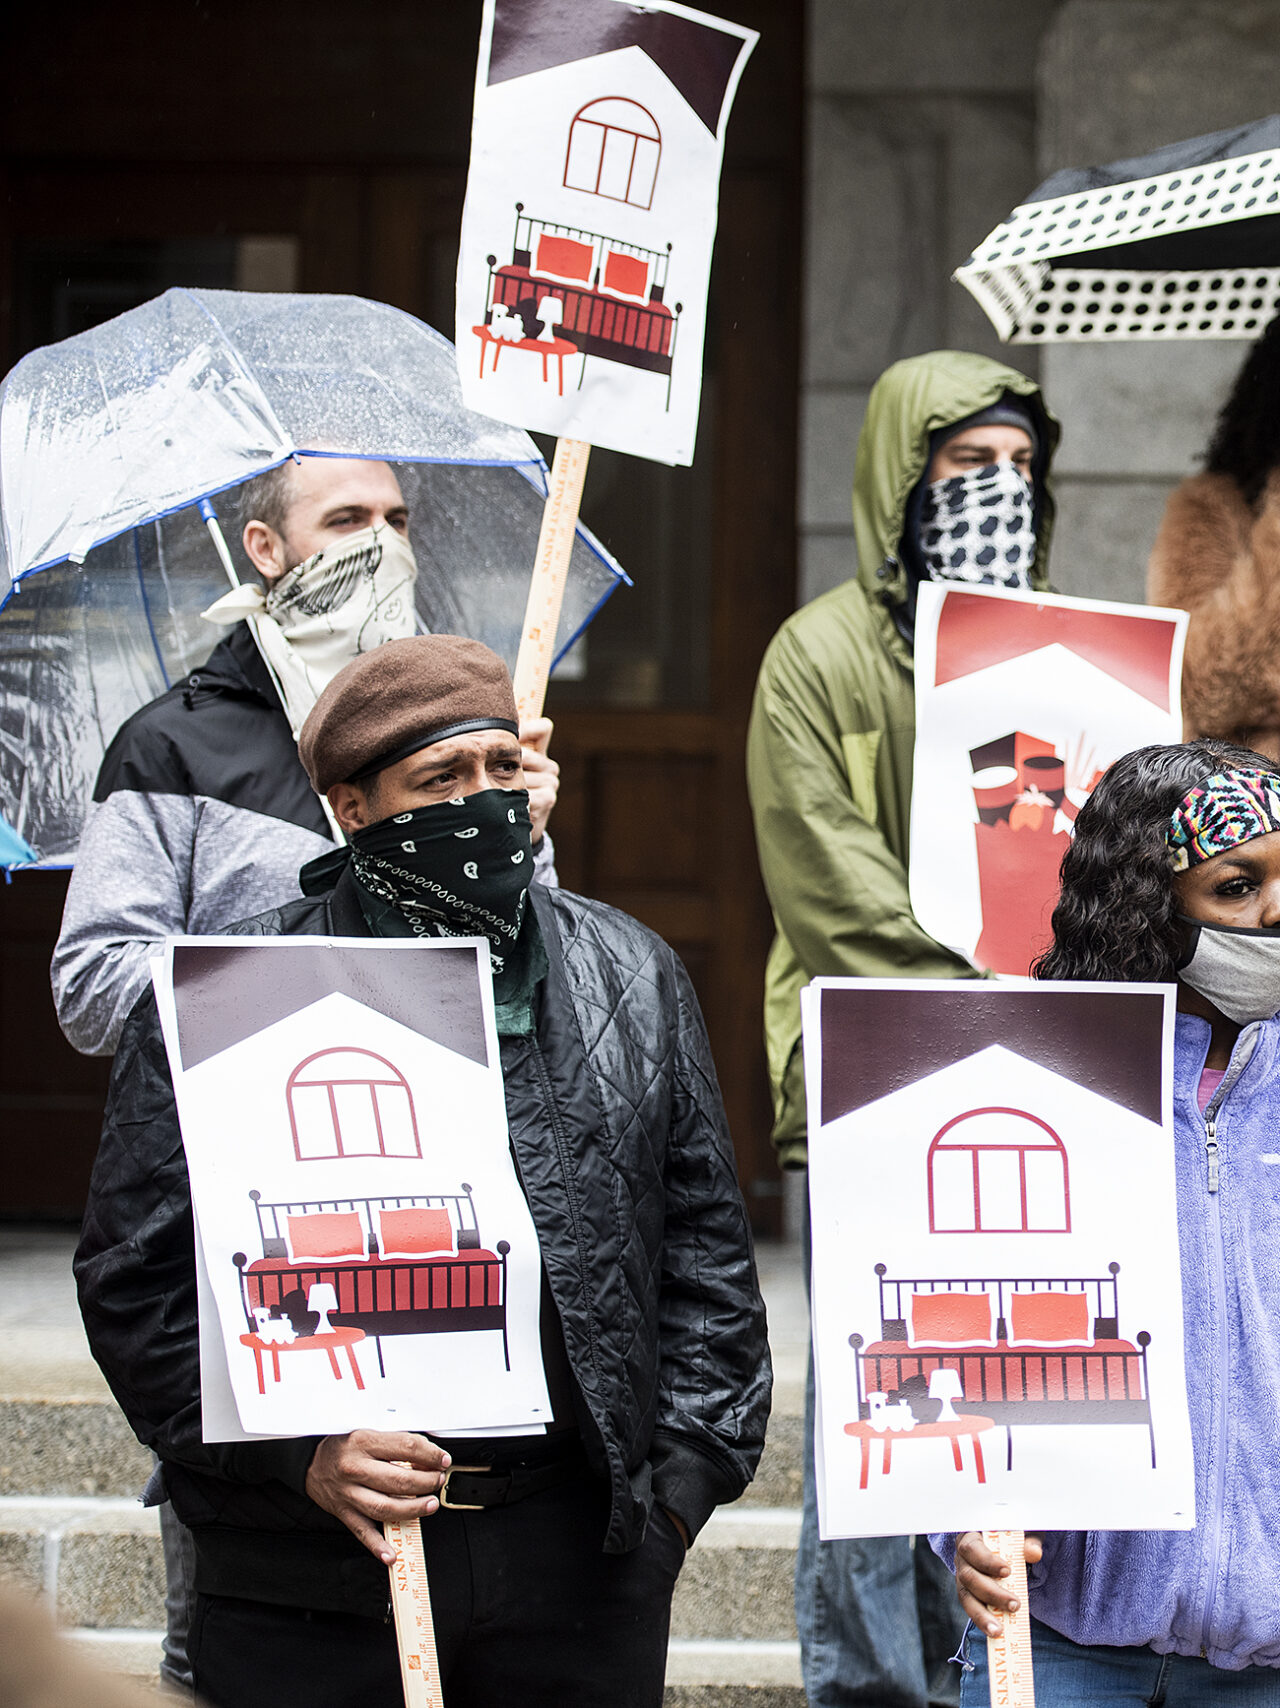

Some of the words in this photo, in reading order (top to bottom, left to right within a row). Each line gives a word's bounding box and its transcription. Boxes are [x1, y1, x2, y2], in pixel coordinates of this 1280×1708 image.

[405, 1534, 413, 1546] 23
[393, 1538, 409, 1592] PAINTS
[408, 1561, 416, 1573] 24
[418, 1643, 427, 1655] 27
[1010, 1642, 1019, 1655] 23
[994, 1647, 1009, 1706] PAINTS
[1012, 1672, 1020, 1685] 24
